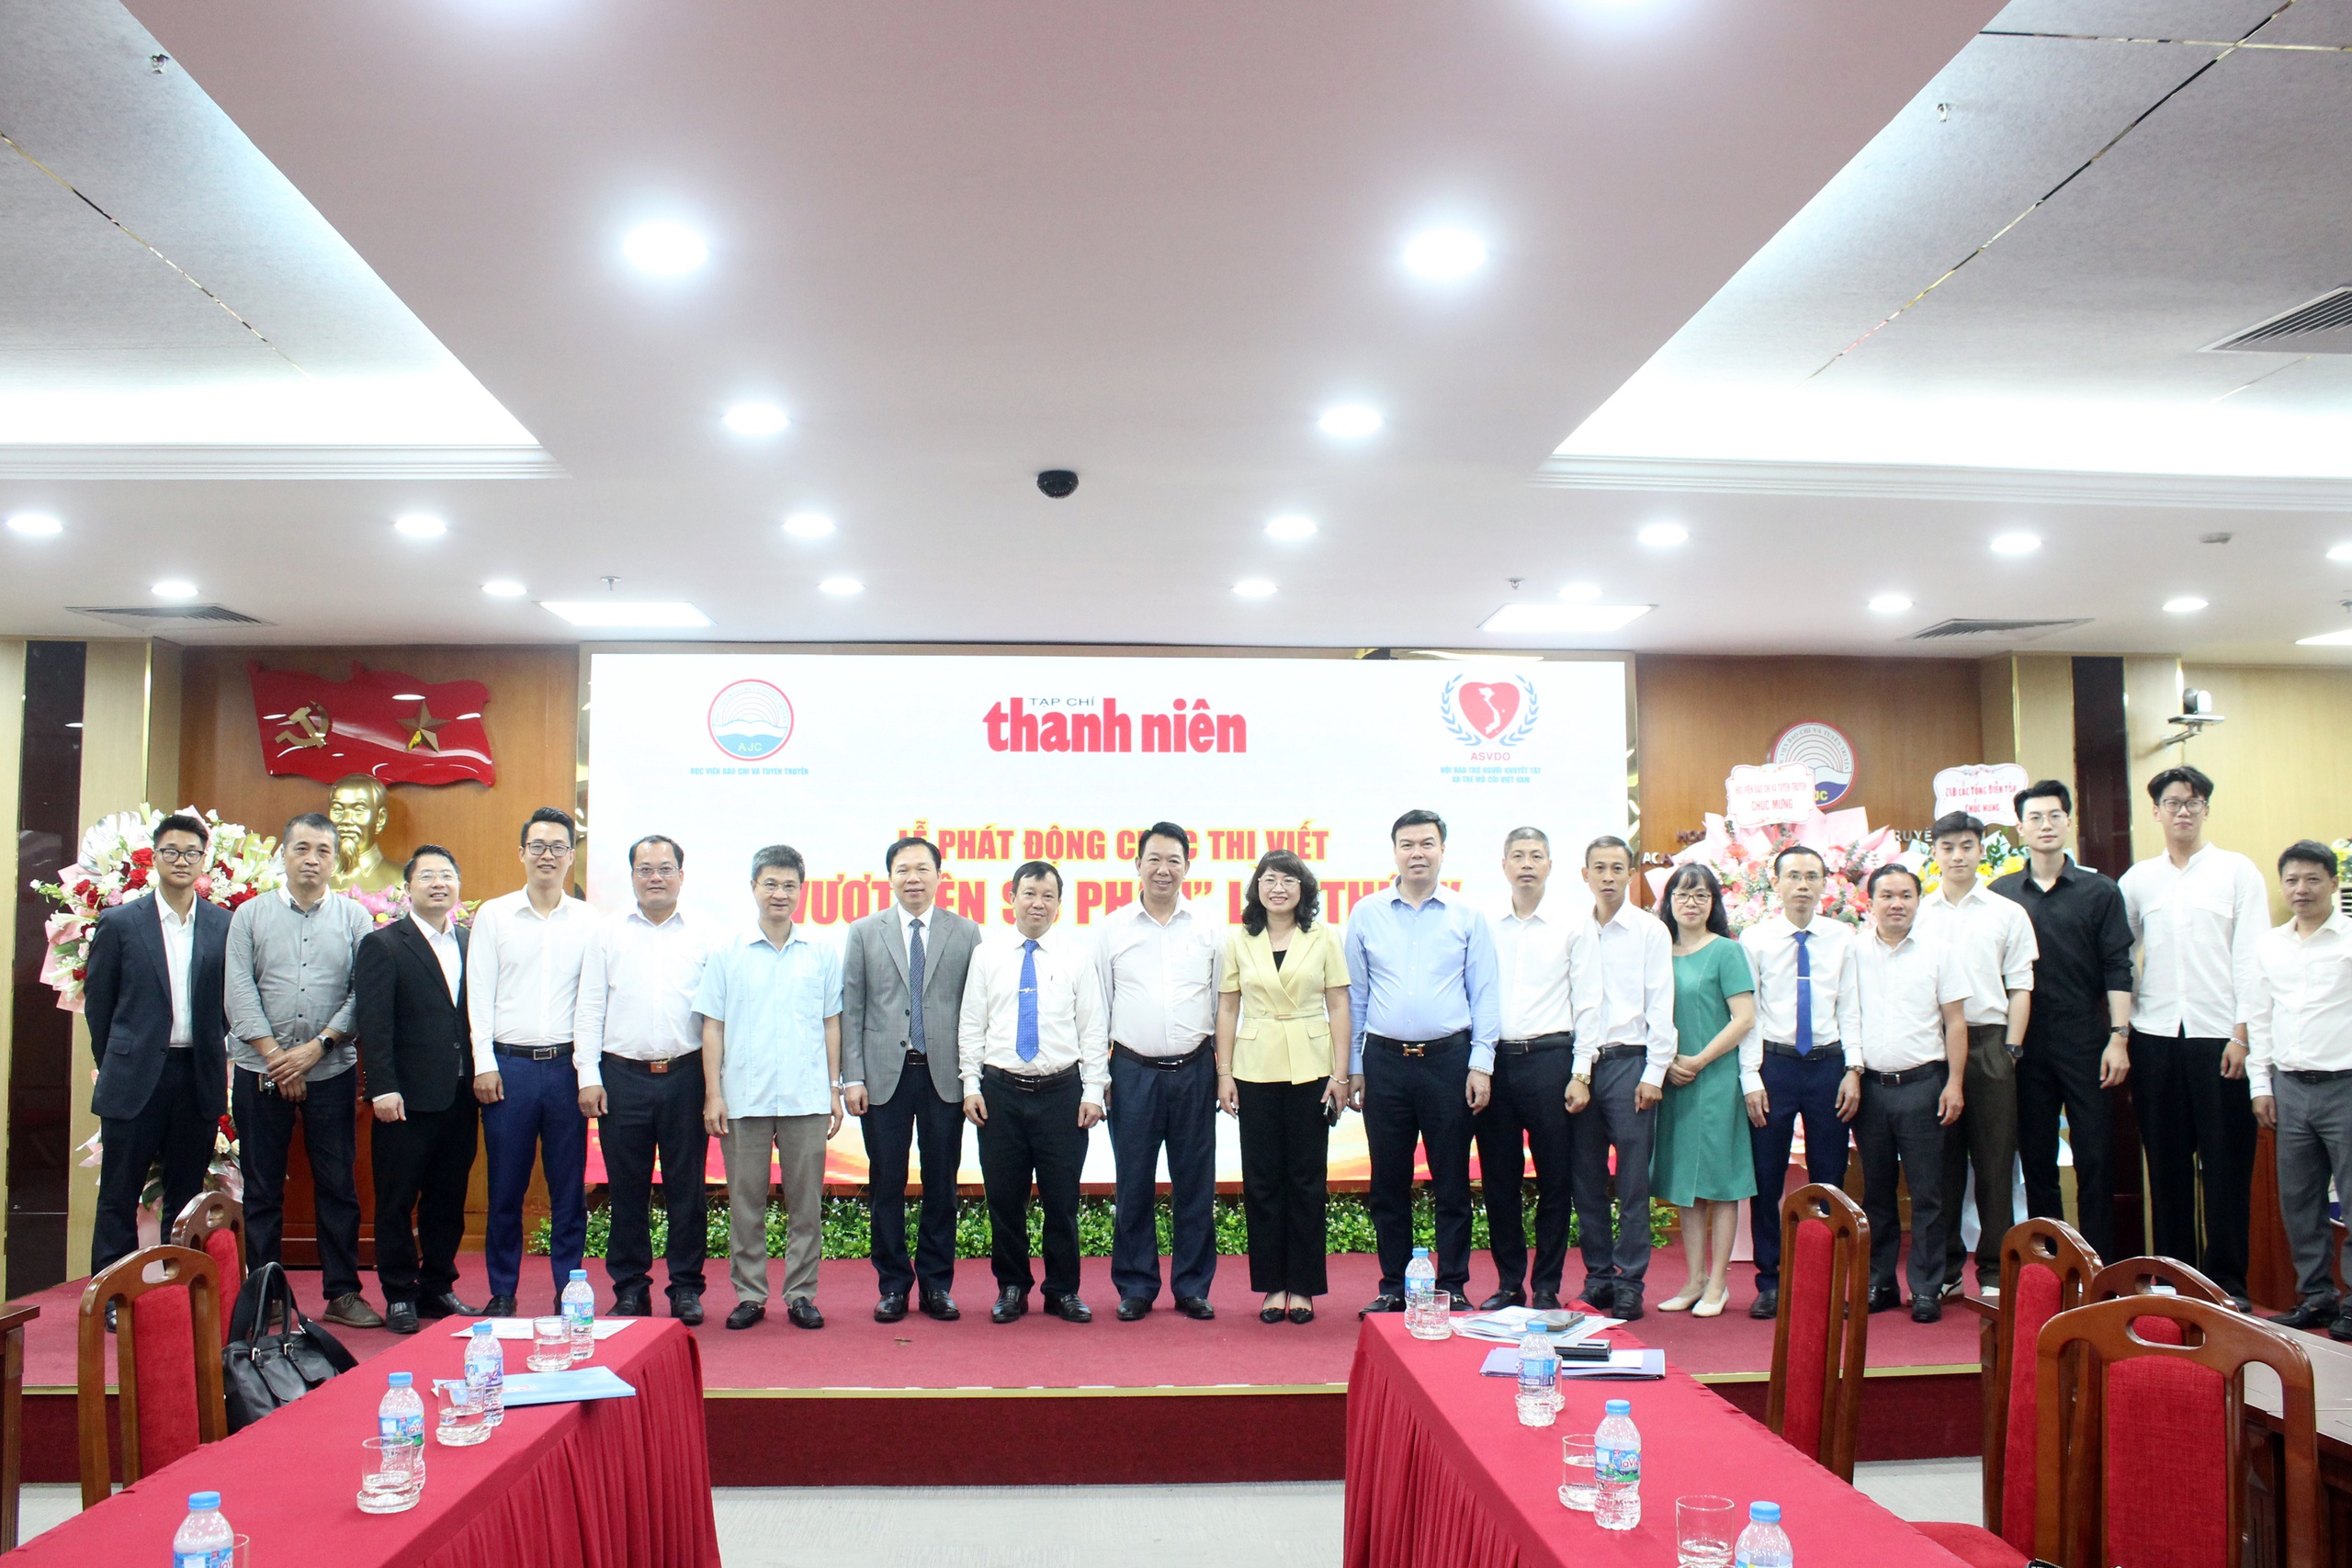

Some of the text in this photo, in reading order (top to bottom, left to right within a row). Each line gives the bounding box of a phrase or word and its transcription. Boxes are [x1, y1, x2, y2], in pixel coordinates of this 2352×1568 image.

[1029, 696, 1095, 708] TẠP CHÍ
[982, 697, 1247, 753] thanh niên
[738, 742, 763, 752] AJC
[1470, 751, 1511, 761] ASVDO
[1815, 790, 1828, 801] JC
[938, 825, 1014, 859] PHÁT
[1023, 825, 1105, 864] ĐỘNG
[1116, 829, 1198, 860] CC
[1207, 830, 1256, 860] THI
[1265, 820, 1329, 860] VIẾT
[934, 873, 986, 924] ÊN
